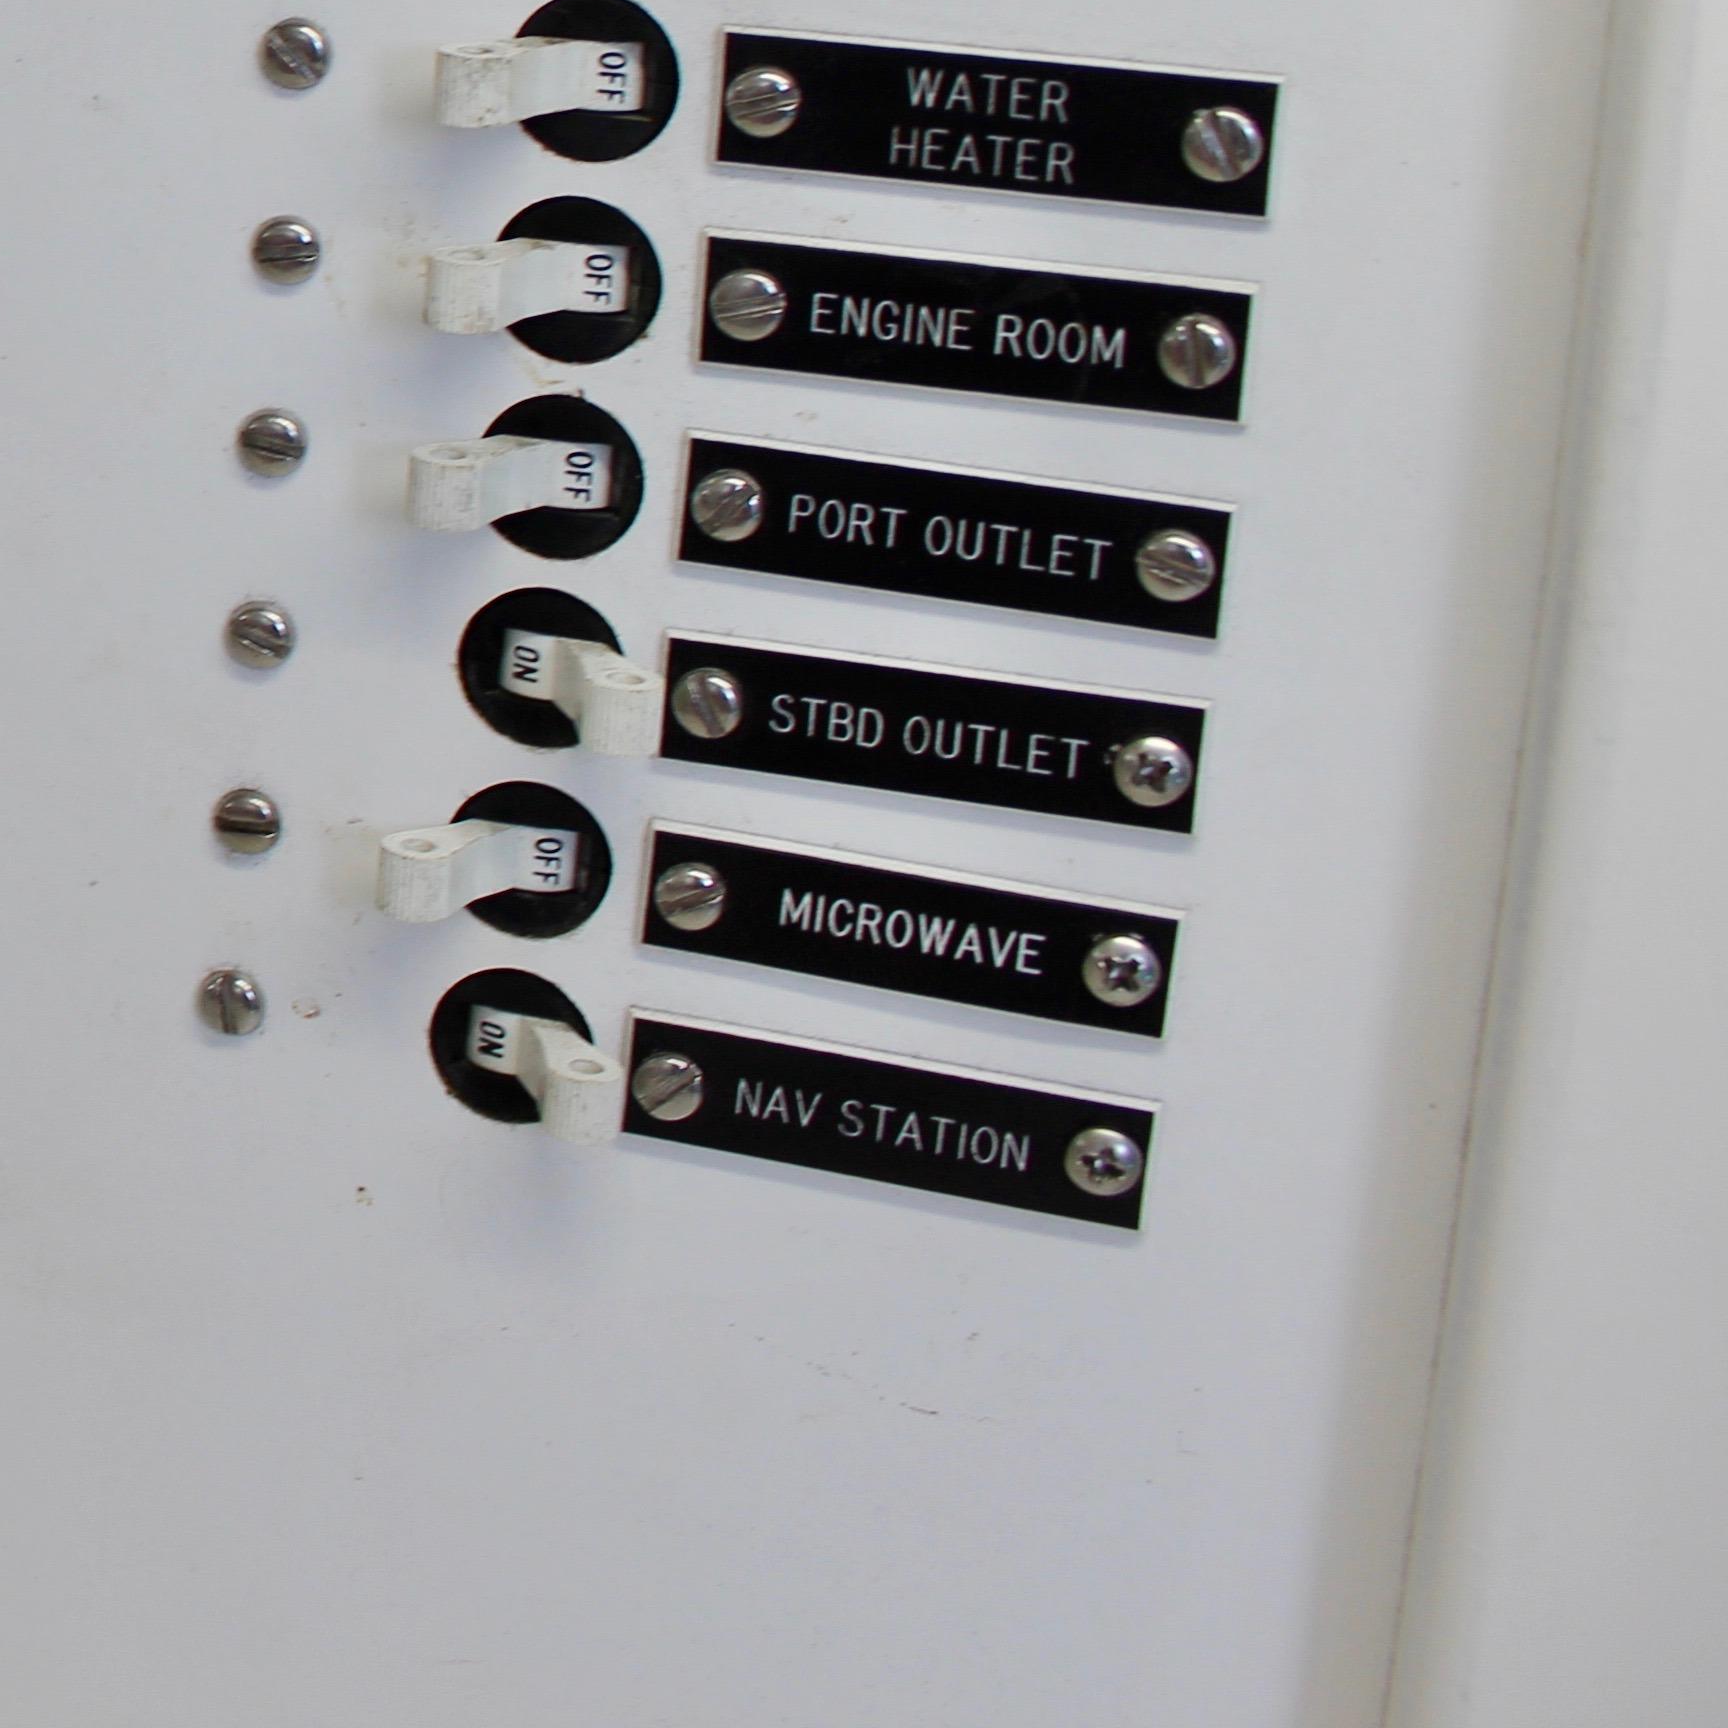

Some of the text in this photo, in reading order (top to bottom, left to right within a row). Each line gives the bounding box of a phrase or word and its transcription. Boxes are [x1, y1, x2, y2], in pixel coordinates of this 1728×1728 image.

[594, 49, 627, 107] OFF
[905, 68, 1071, 124] WATER
[887, 126, 1076, 184] HEATER
[581, 250, 613, 308] OFF
[808, 292, 1128, 366] ENGINE ROOM
[562, 449, 595, 505] OFF
[787, 491, 1114, 583] PORT OUTLET
[512, 643, 542, 684] ON
[768, 692, 1091, 781] STBD OUTLET
[531, 835, 563, 891] OFF
[777, 885, 1047, 976] MICROWAVE
[477, 1019, 506, 1059] ON
[732, 1077, 1031, 1173] NAV STATION
